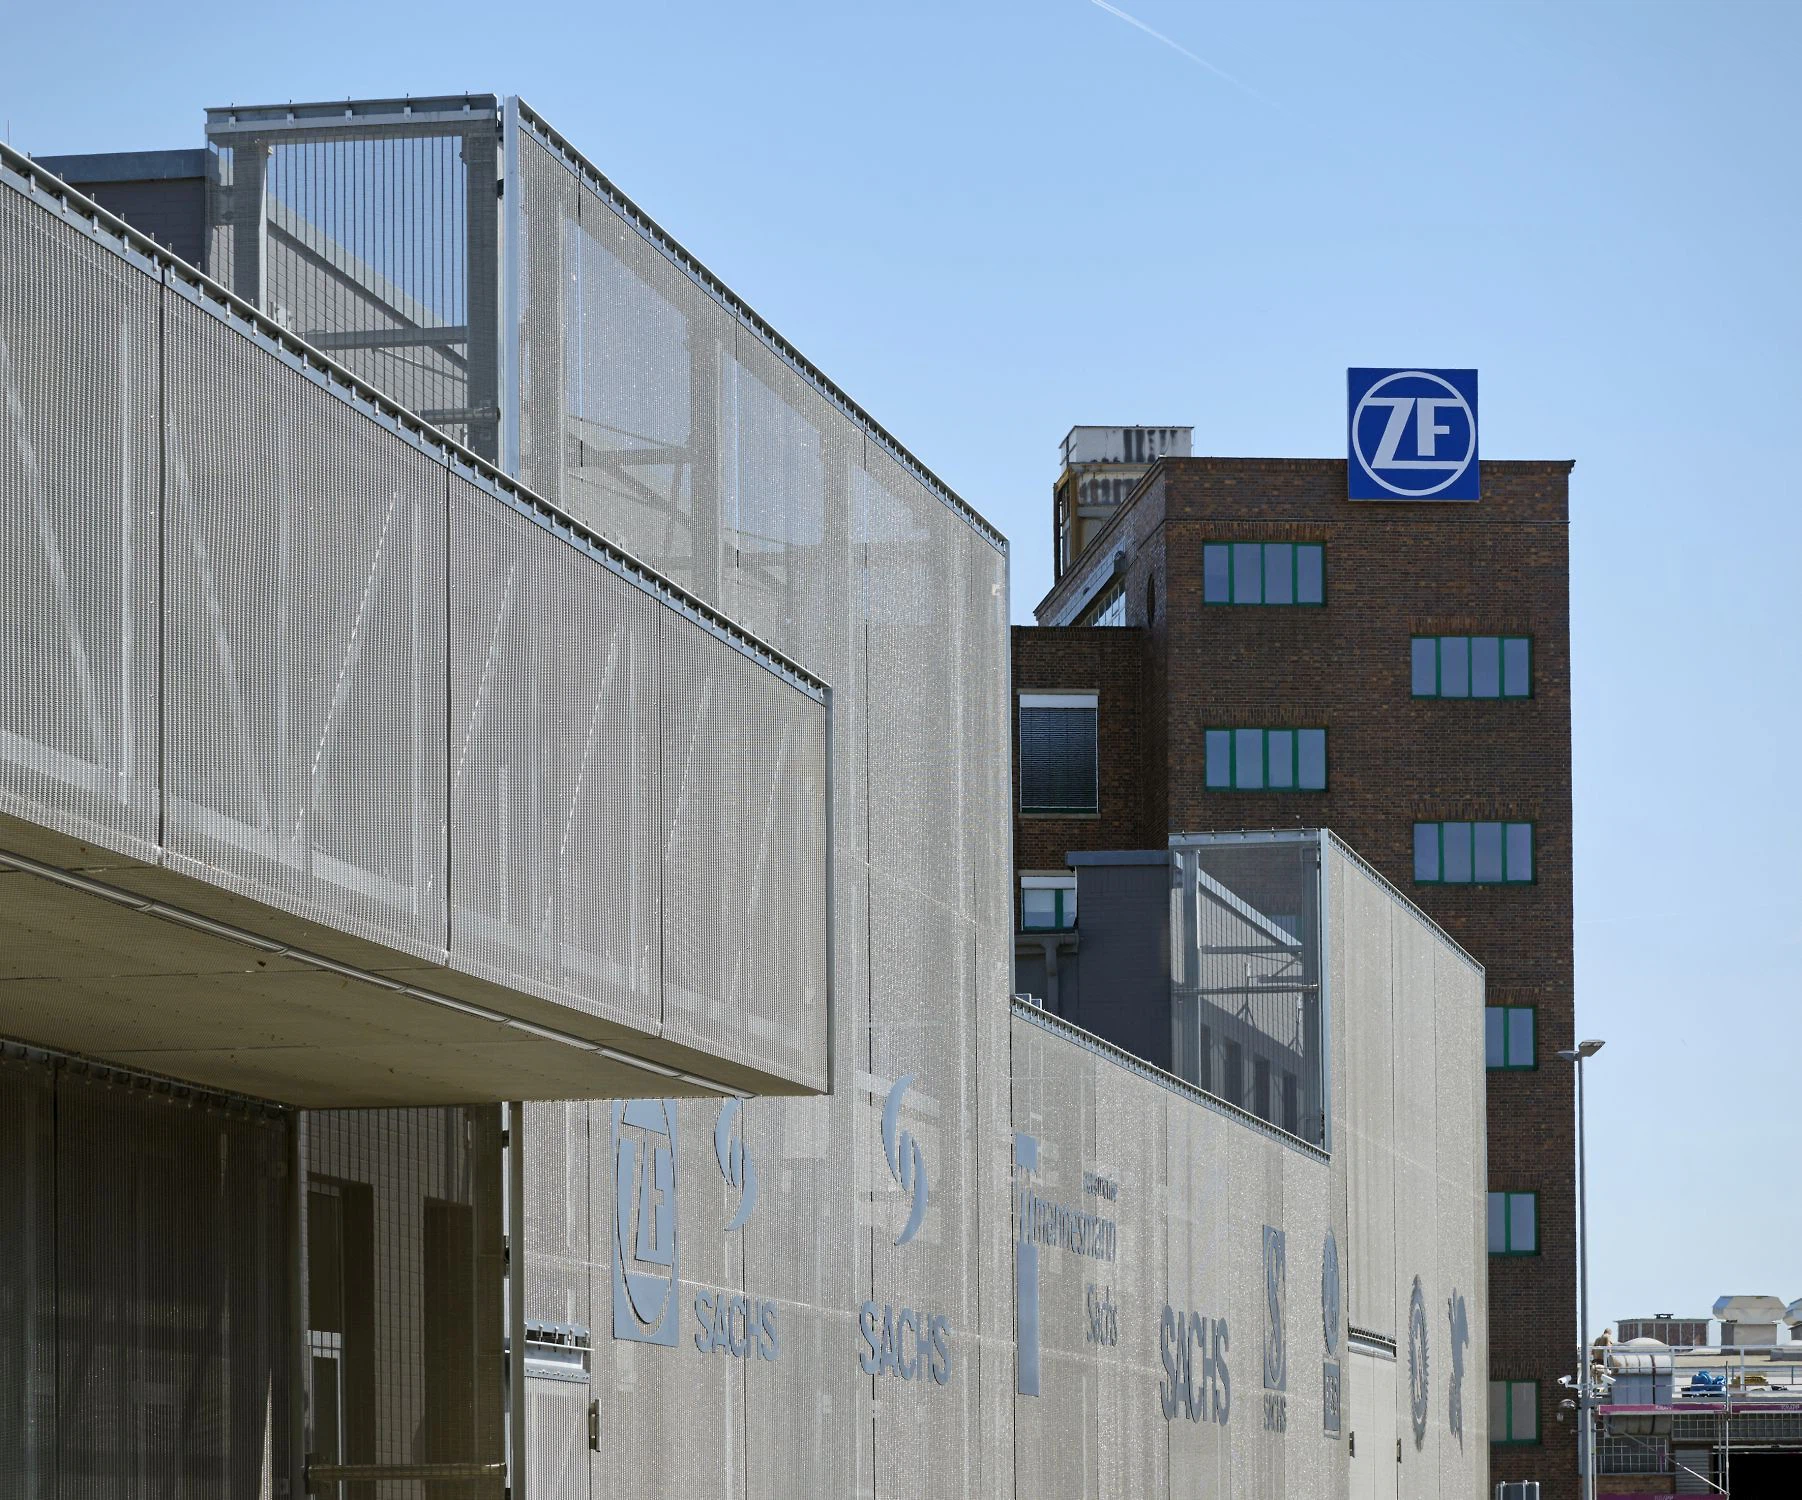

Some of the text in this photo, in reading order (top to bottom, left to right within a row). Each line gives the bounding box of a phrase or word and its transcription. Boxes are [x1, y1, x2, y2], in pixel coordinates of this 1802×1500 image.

[1362, 397, 1465, 470] ZF
[619, 1120, 672, 1278] ZF
[694, 1290, 780, 1362] SACHS
[859, 1301, 952, 1385] SACHS
[1087, 1284, 1118, 1347] Sachs
[1160, 1304, 1230, 1426] SACHS
[1264, 1394, 1286, 1433] SACHS
